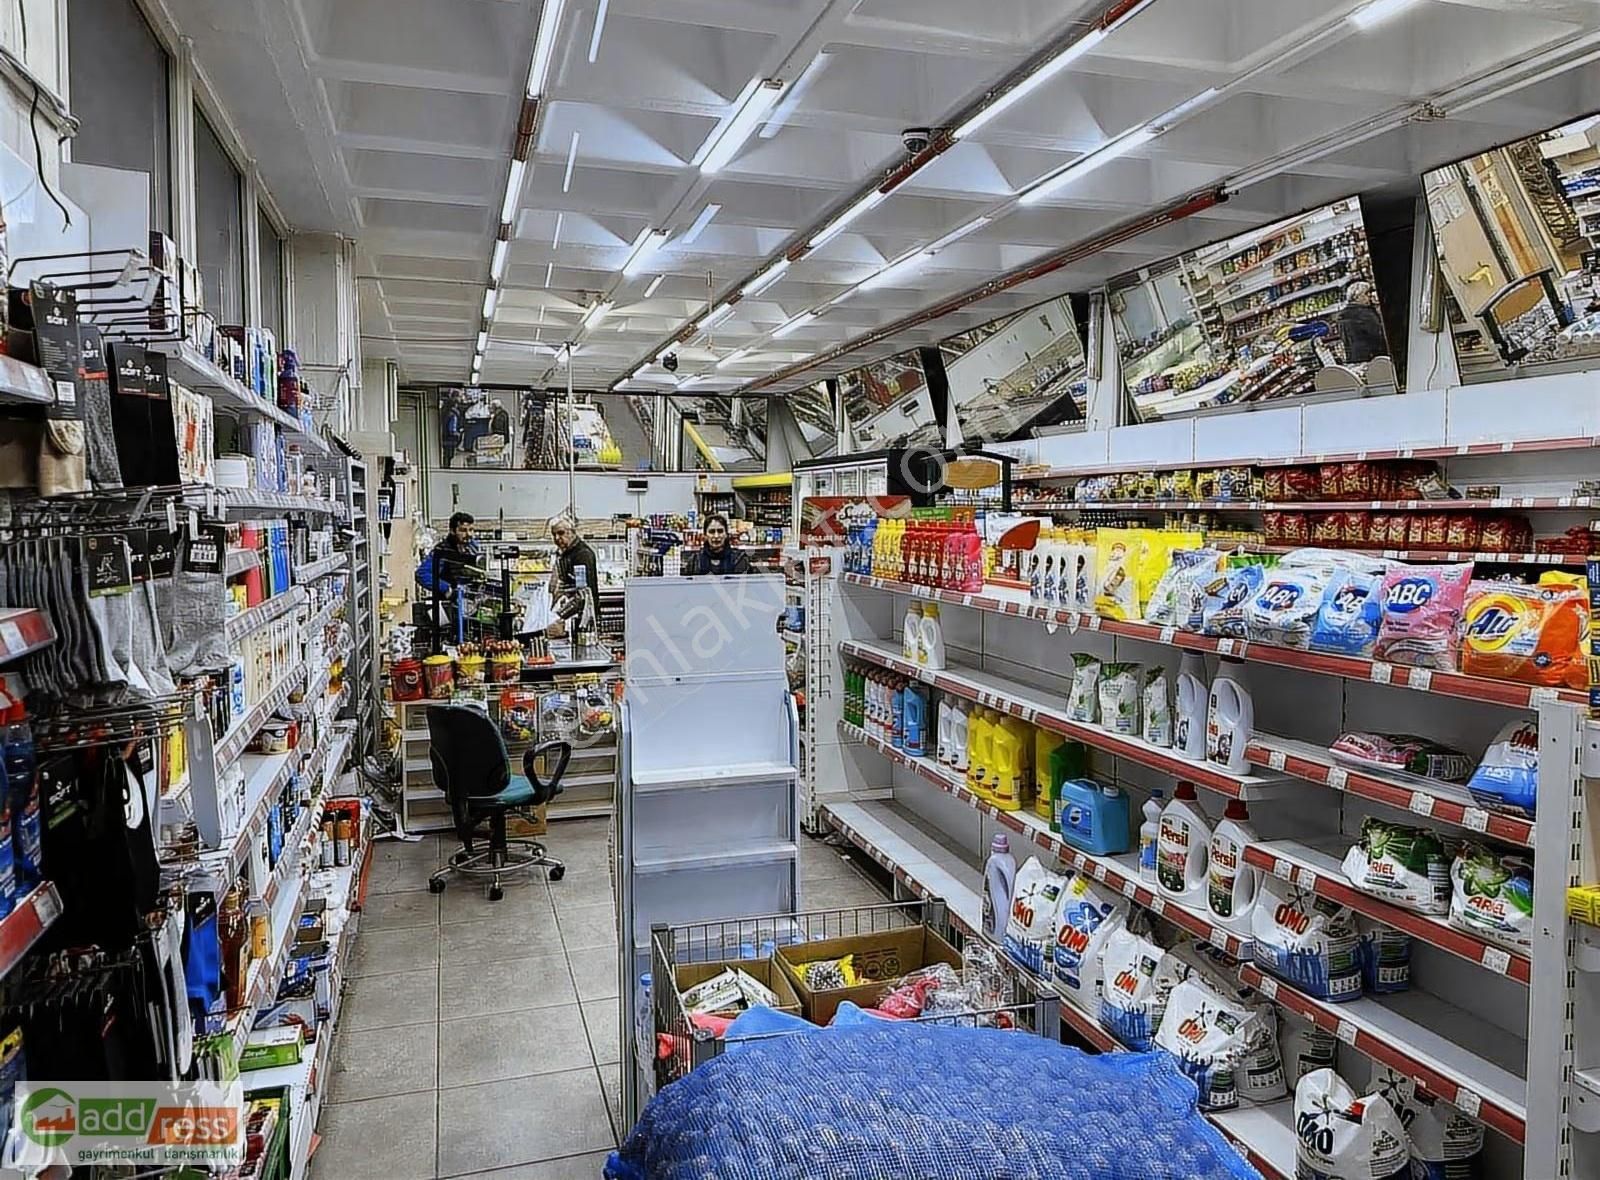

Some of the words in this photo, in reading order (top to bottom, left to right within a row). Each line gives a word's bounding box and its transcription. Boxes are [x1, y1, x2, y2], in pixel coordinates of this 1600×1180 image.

[150, 552, 171, 562] SOFT
[1264, 586, 1297, 605] ABC
[1387, 584, 1430, 605] ABC
[1510, 729, 1538, 751] OM
[1161, 824, 1189, 848] Persil
[1211, 845, 1237, 869] Persil
[1467, 896, 1506, 916] ARIEL
[1274, 903, 1311, 935] OMO
